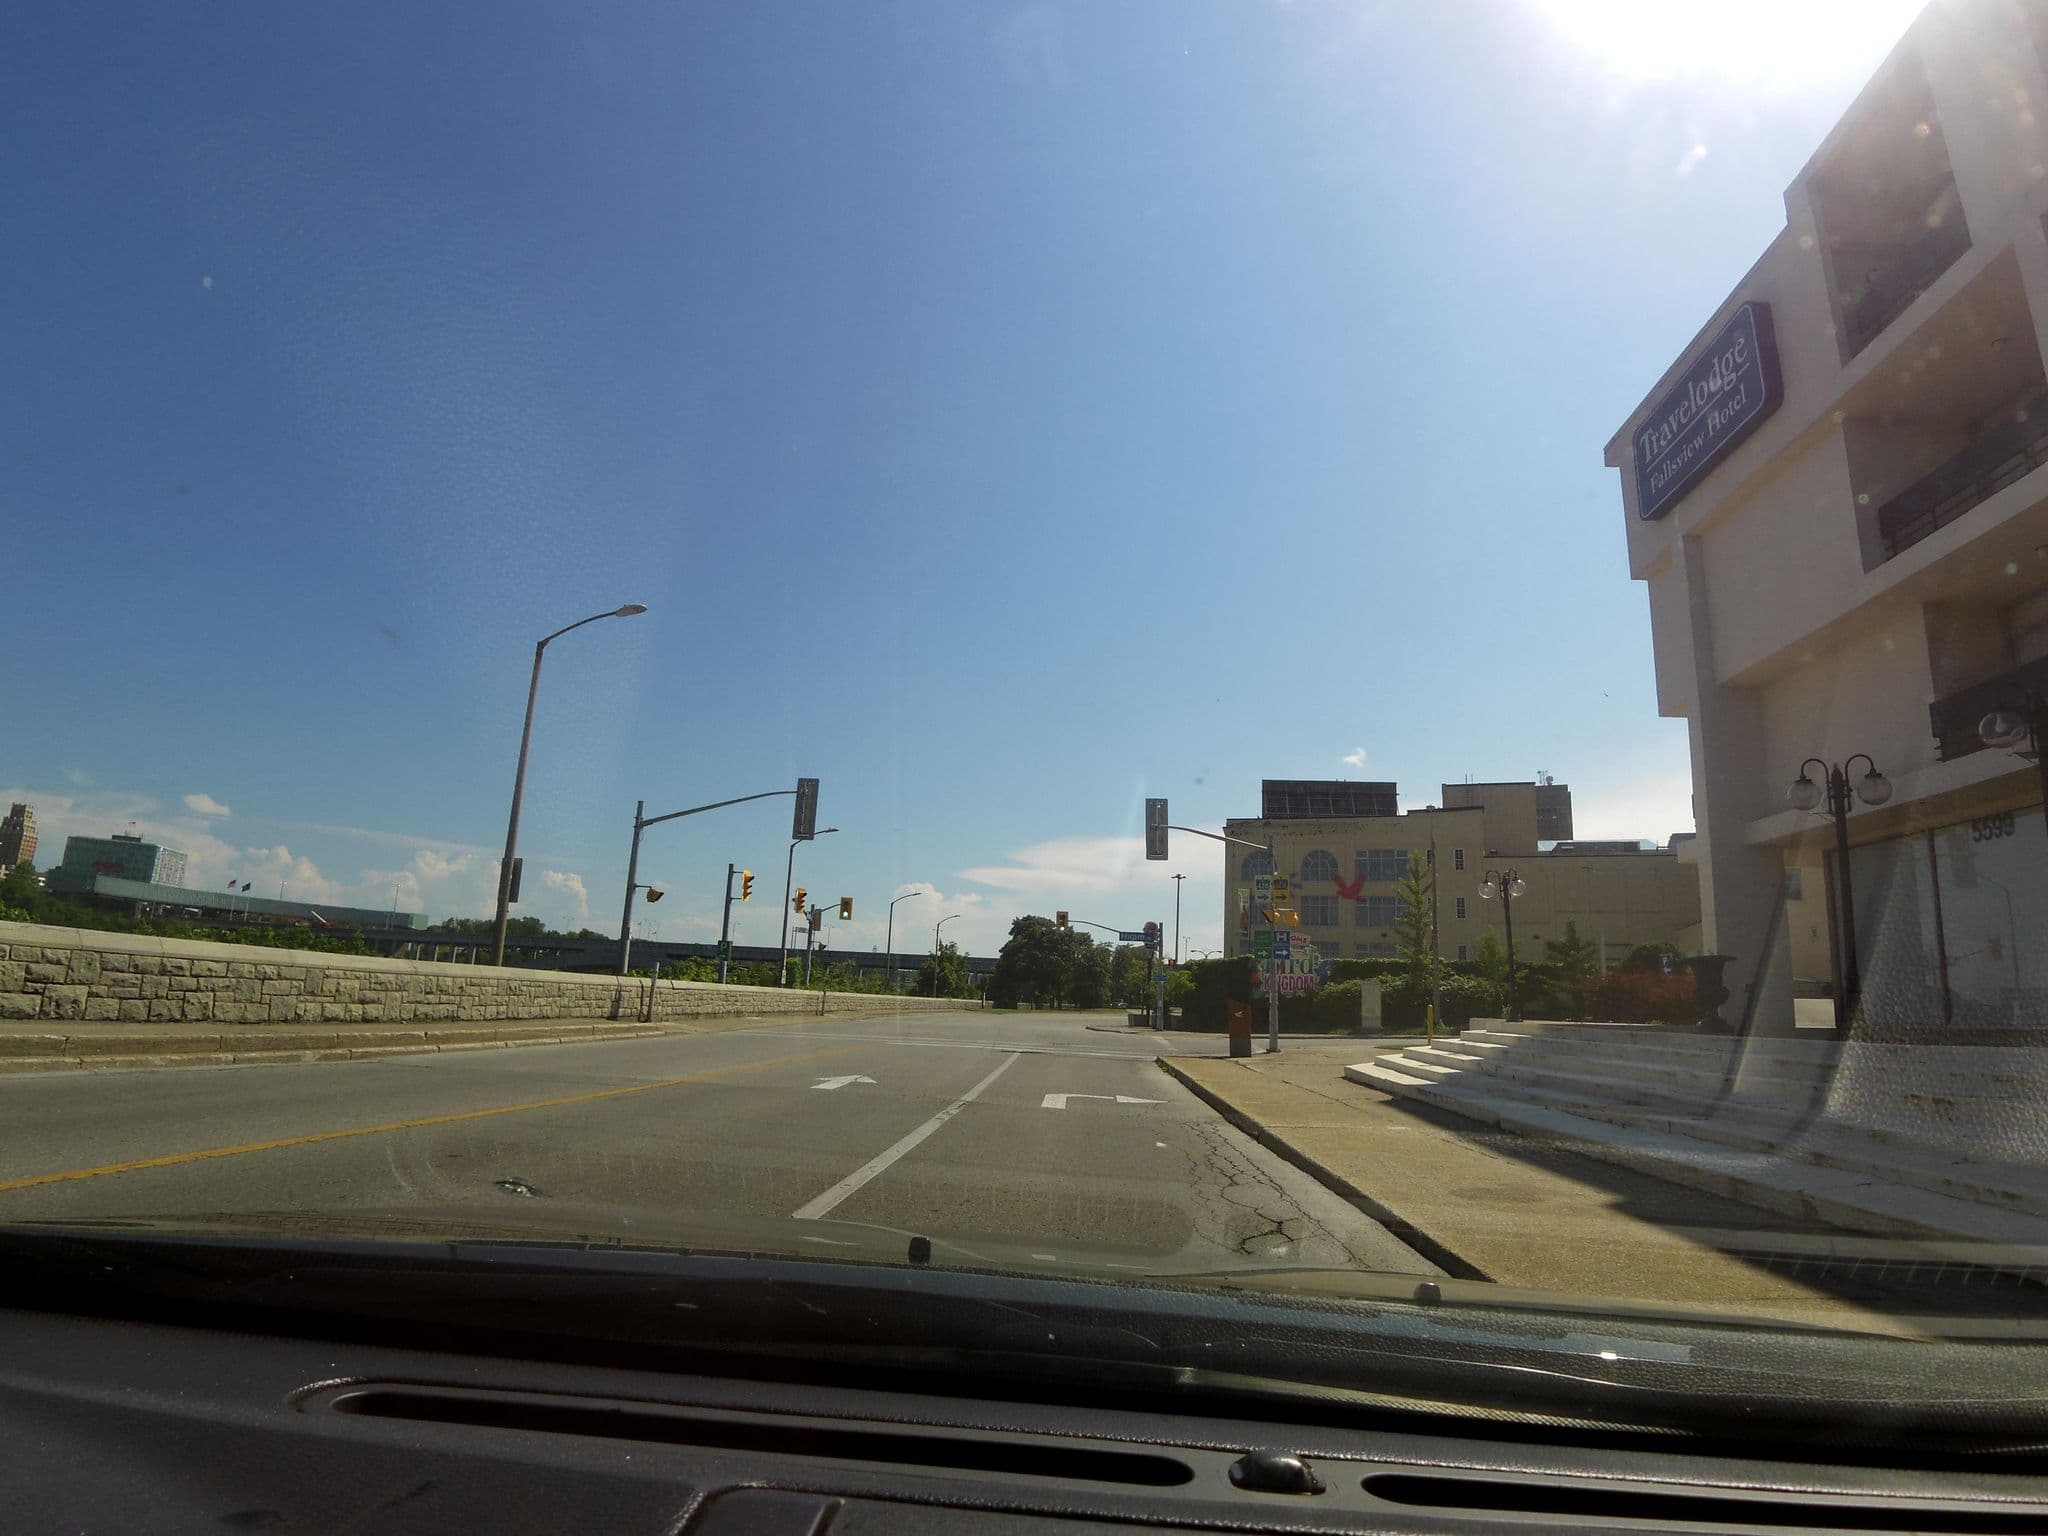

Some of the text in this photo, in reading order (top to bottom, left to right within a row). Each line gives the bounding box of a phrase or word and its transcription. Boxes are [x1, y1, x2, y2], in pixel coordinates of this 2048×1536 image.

[1640, 337, 1748, 464] Travelodge
[1649, 384, 1747, 494] Fallsview Hotel
[1120, 932, 1145, 940] Hiram
[1276, 932, 1287, 942] H
[1264, 975, 1314, 992] KNGDOM
